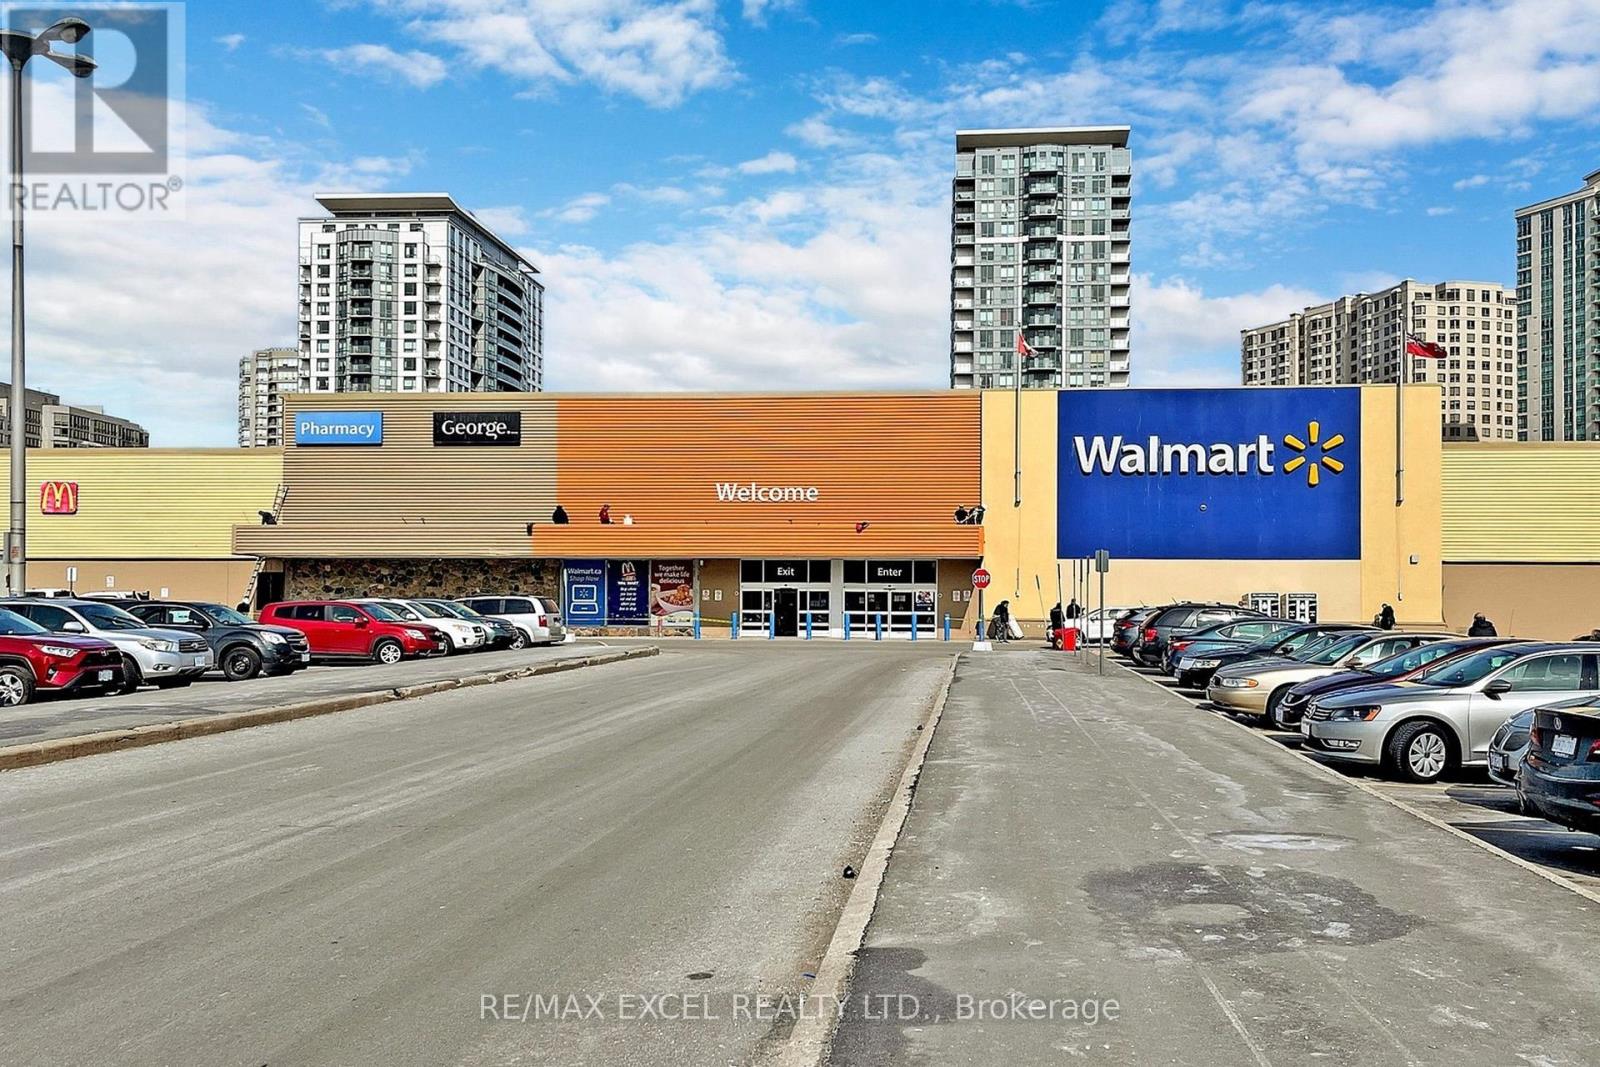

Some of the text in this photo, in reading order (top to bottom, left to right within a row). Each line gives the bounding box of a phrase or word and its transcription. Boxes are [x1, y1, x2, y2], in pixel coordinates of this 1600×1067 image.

[301, 422, 375, 438] Pharmacy
[1074, 435, 1274, 474] Walmart
[715, 482, 819, 501] Welcome
[567, 567, 602, 575] Walmart.ca
[658, 564, 685, 572] Together
[777, 567, 795, 576] Exit
[877, 567, 902, 577] Enter
[973, 574, 990, 584] STOP
